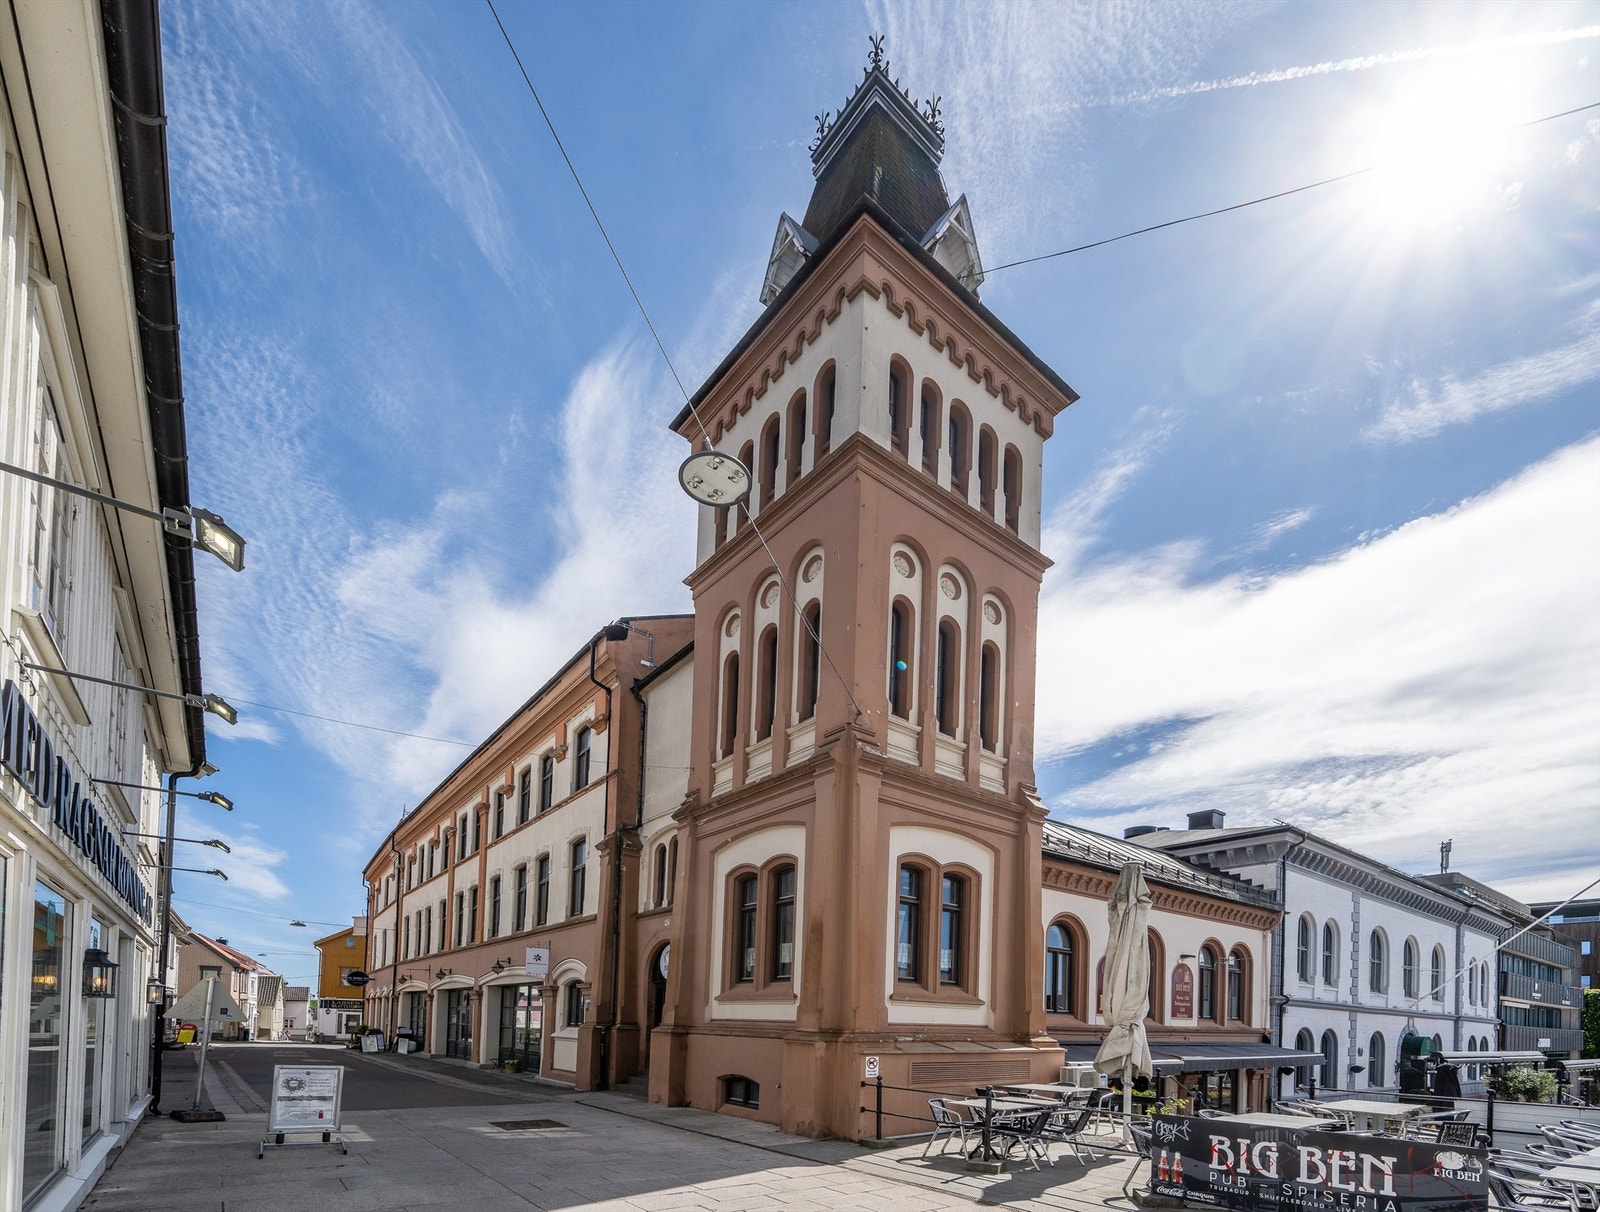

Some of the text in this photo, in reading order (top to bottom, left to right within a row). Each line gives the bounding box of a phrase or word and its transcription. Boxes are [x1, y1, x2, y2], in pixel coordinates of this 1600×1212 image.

[54, 756, 116, 887] RAGNAR
[1208, 1134, 1398, 1198] BIG BEN
[1433, 1167, 1480, 1183] BIG BEN
[1208, 1171, 1247, 1188] PUB
[1282, 1183, 1397, 1212] SPISERIA
[1209, 1184, 1250, 1196] TRUBADUR
[1259, 1193, 1325, 1209] SHUFFLEBOARD
